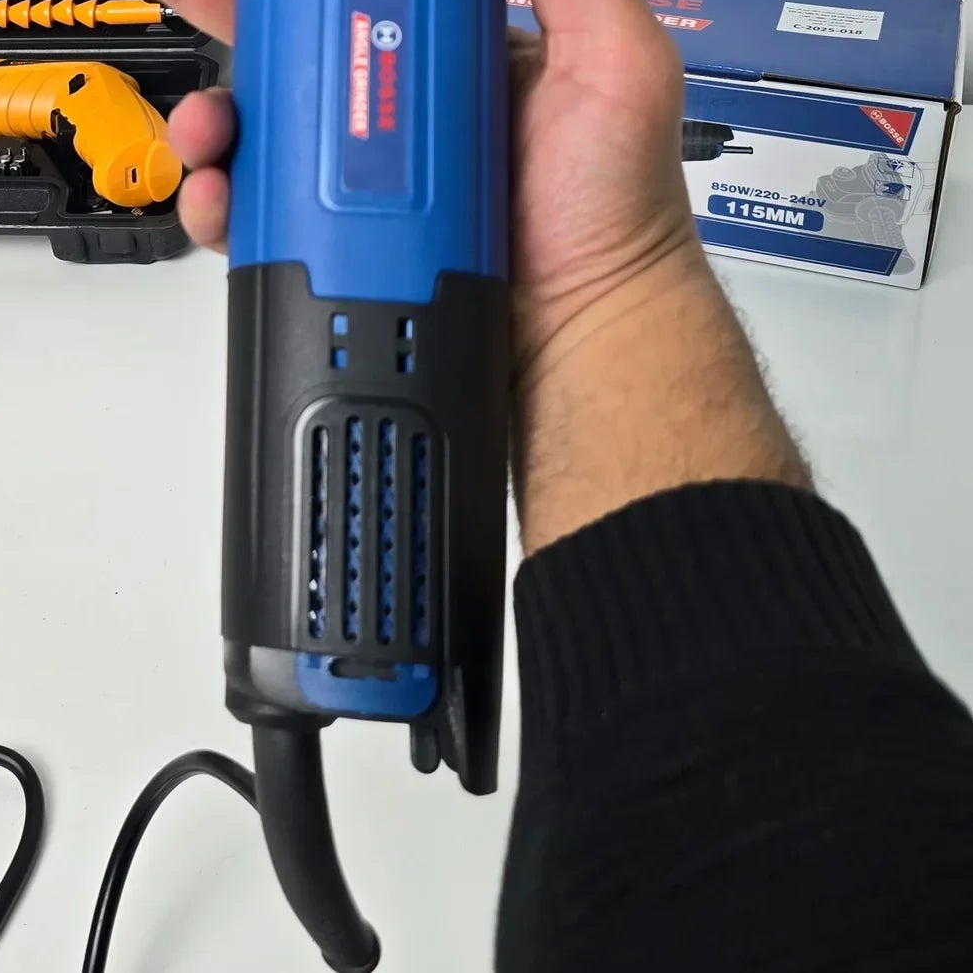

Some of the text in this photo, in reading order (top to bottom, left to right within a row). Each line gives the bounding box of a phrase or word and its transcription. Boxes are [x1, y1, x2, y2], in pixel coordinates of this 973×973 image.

[793, 23, 863, 35] C-2025-018
[878, 117, 905, 144] BOSSE
[711, 181, 827, 208] 850W/220-240V
[726, 200, 805, 226] 115MM
